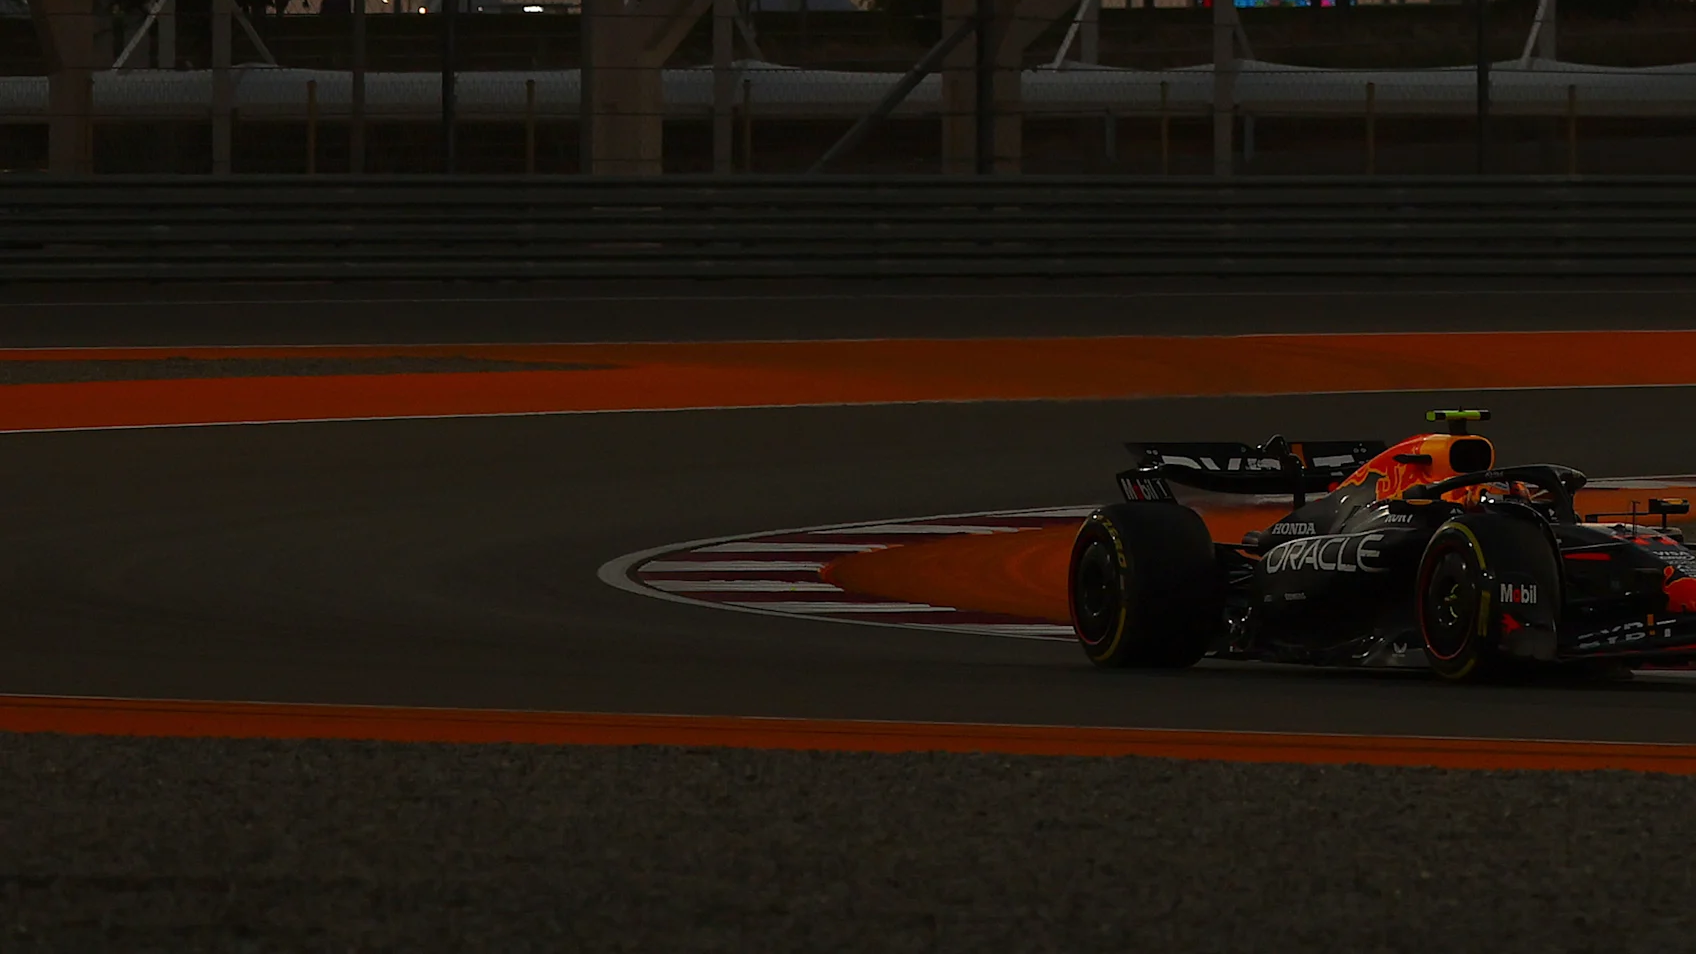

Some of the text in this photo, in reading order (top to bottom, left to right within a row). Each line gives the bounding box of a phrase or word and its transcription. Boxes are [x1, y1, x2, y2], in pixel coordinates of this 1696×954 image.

[1120, 478, 1160, 501] Mobil
[1272, 522, 1317, 536] HONDA
[1265, 532, 1390, 574] ORACLE
[1499, 583, 1538, 605] Mobil
